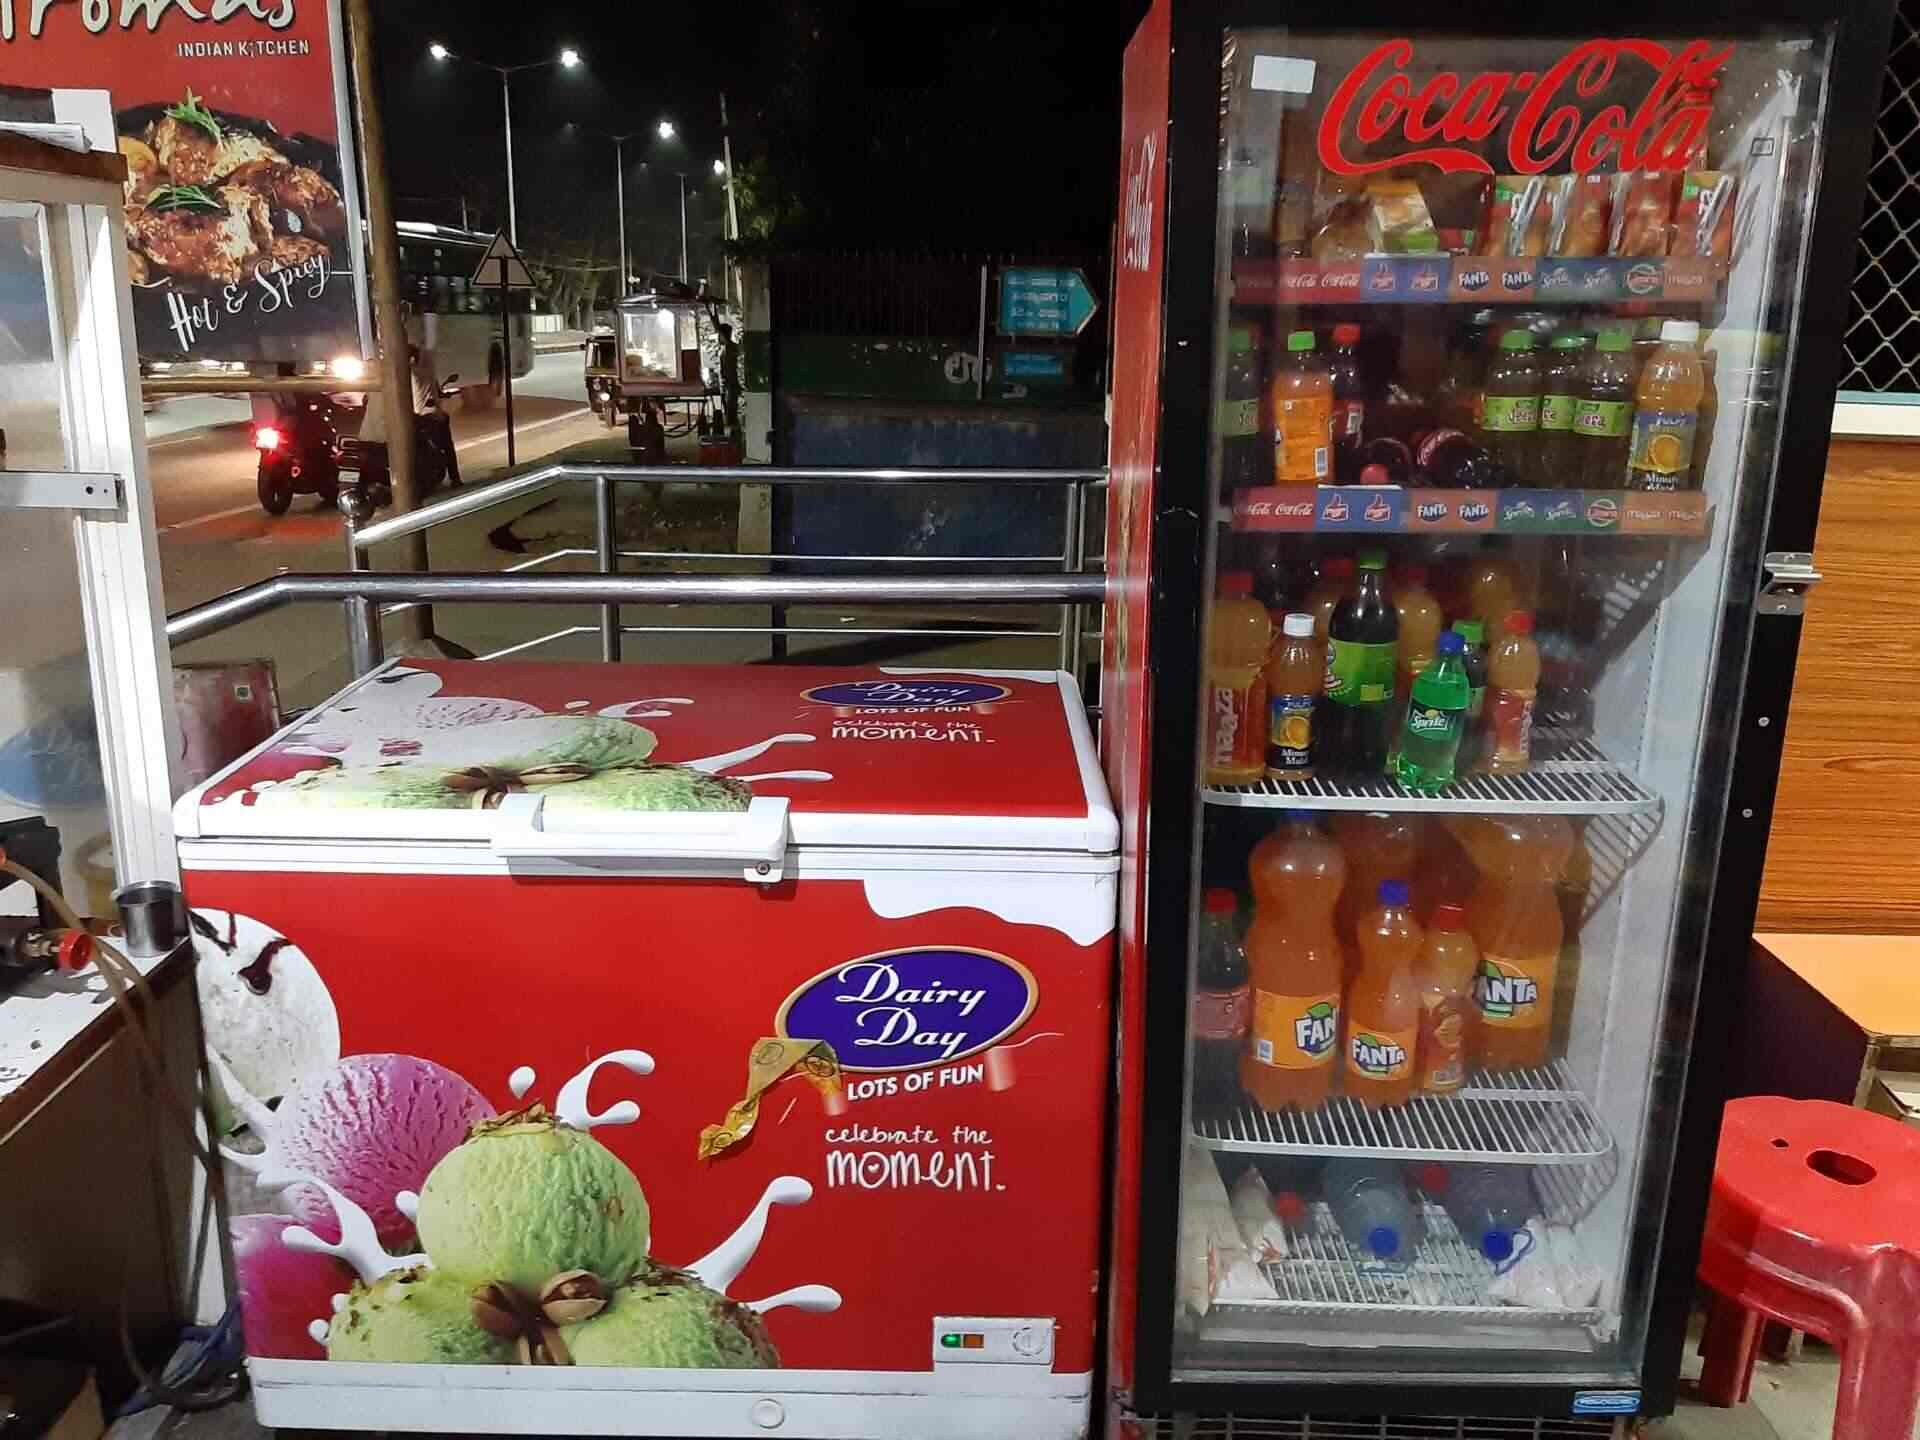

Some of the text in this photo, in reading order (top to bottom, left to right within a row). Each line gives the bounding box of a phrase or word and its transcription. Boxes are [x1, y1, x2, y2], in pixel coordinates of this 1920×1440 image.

[176, 39, 310, 57] INDIAN KITCHEN
[1316, 39, 1728, 175] Coca-Cola
[1457, 271, 1490, 288] FANTA
[1500, 271, 1534, 288] FANTA
[168, 253, 331, 352] Hot & Spicy
[1416, 502, 1448, 518] FANTA
[1458, 502, 1490, 518] FANTA
[850, 682, 971, 695] Dairy
[863, 690, 957, 705] Day
[855, 705, 971, 715] LOTS OF FUN
[832, 719, 982, 730] celebrate the
[1411, 716, 1446, 730] Sprite
[835, 962, 987, 1016] Dairy
[1476, 975, 1537, 1003] ANTA
[854, 1006, 968, 1060] Day
[1294, 1008, 1336, 1048] FAN
[1352, 1037, 1407, 1065] FANTA
[847, 1064, 984, 1101] LOTS OF FUN
[825, 1123, 993, 1144] celebrate the
